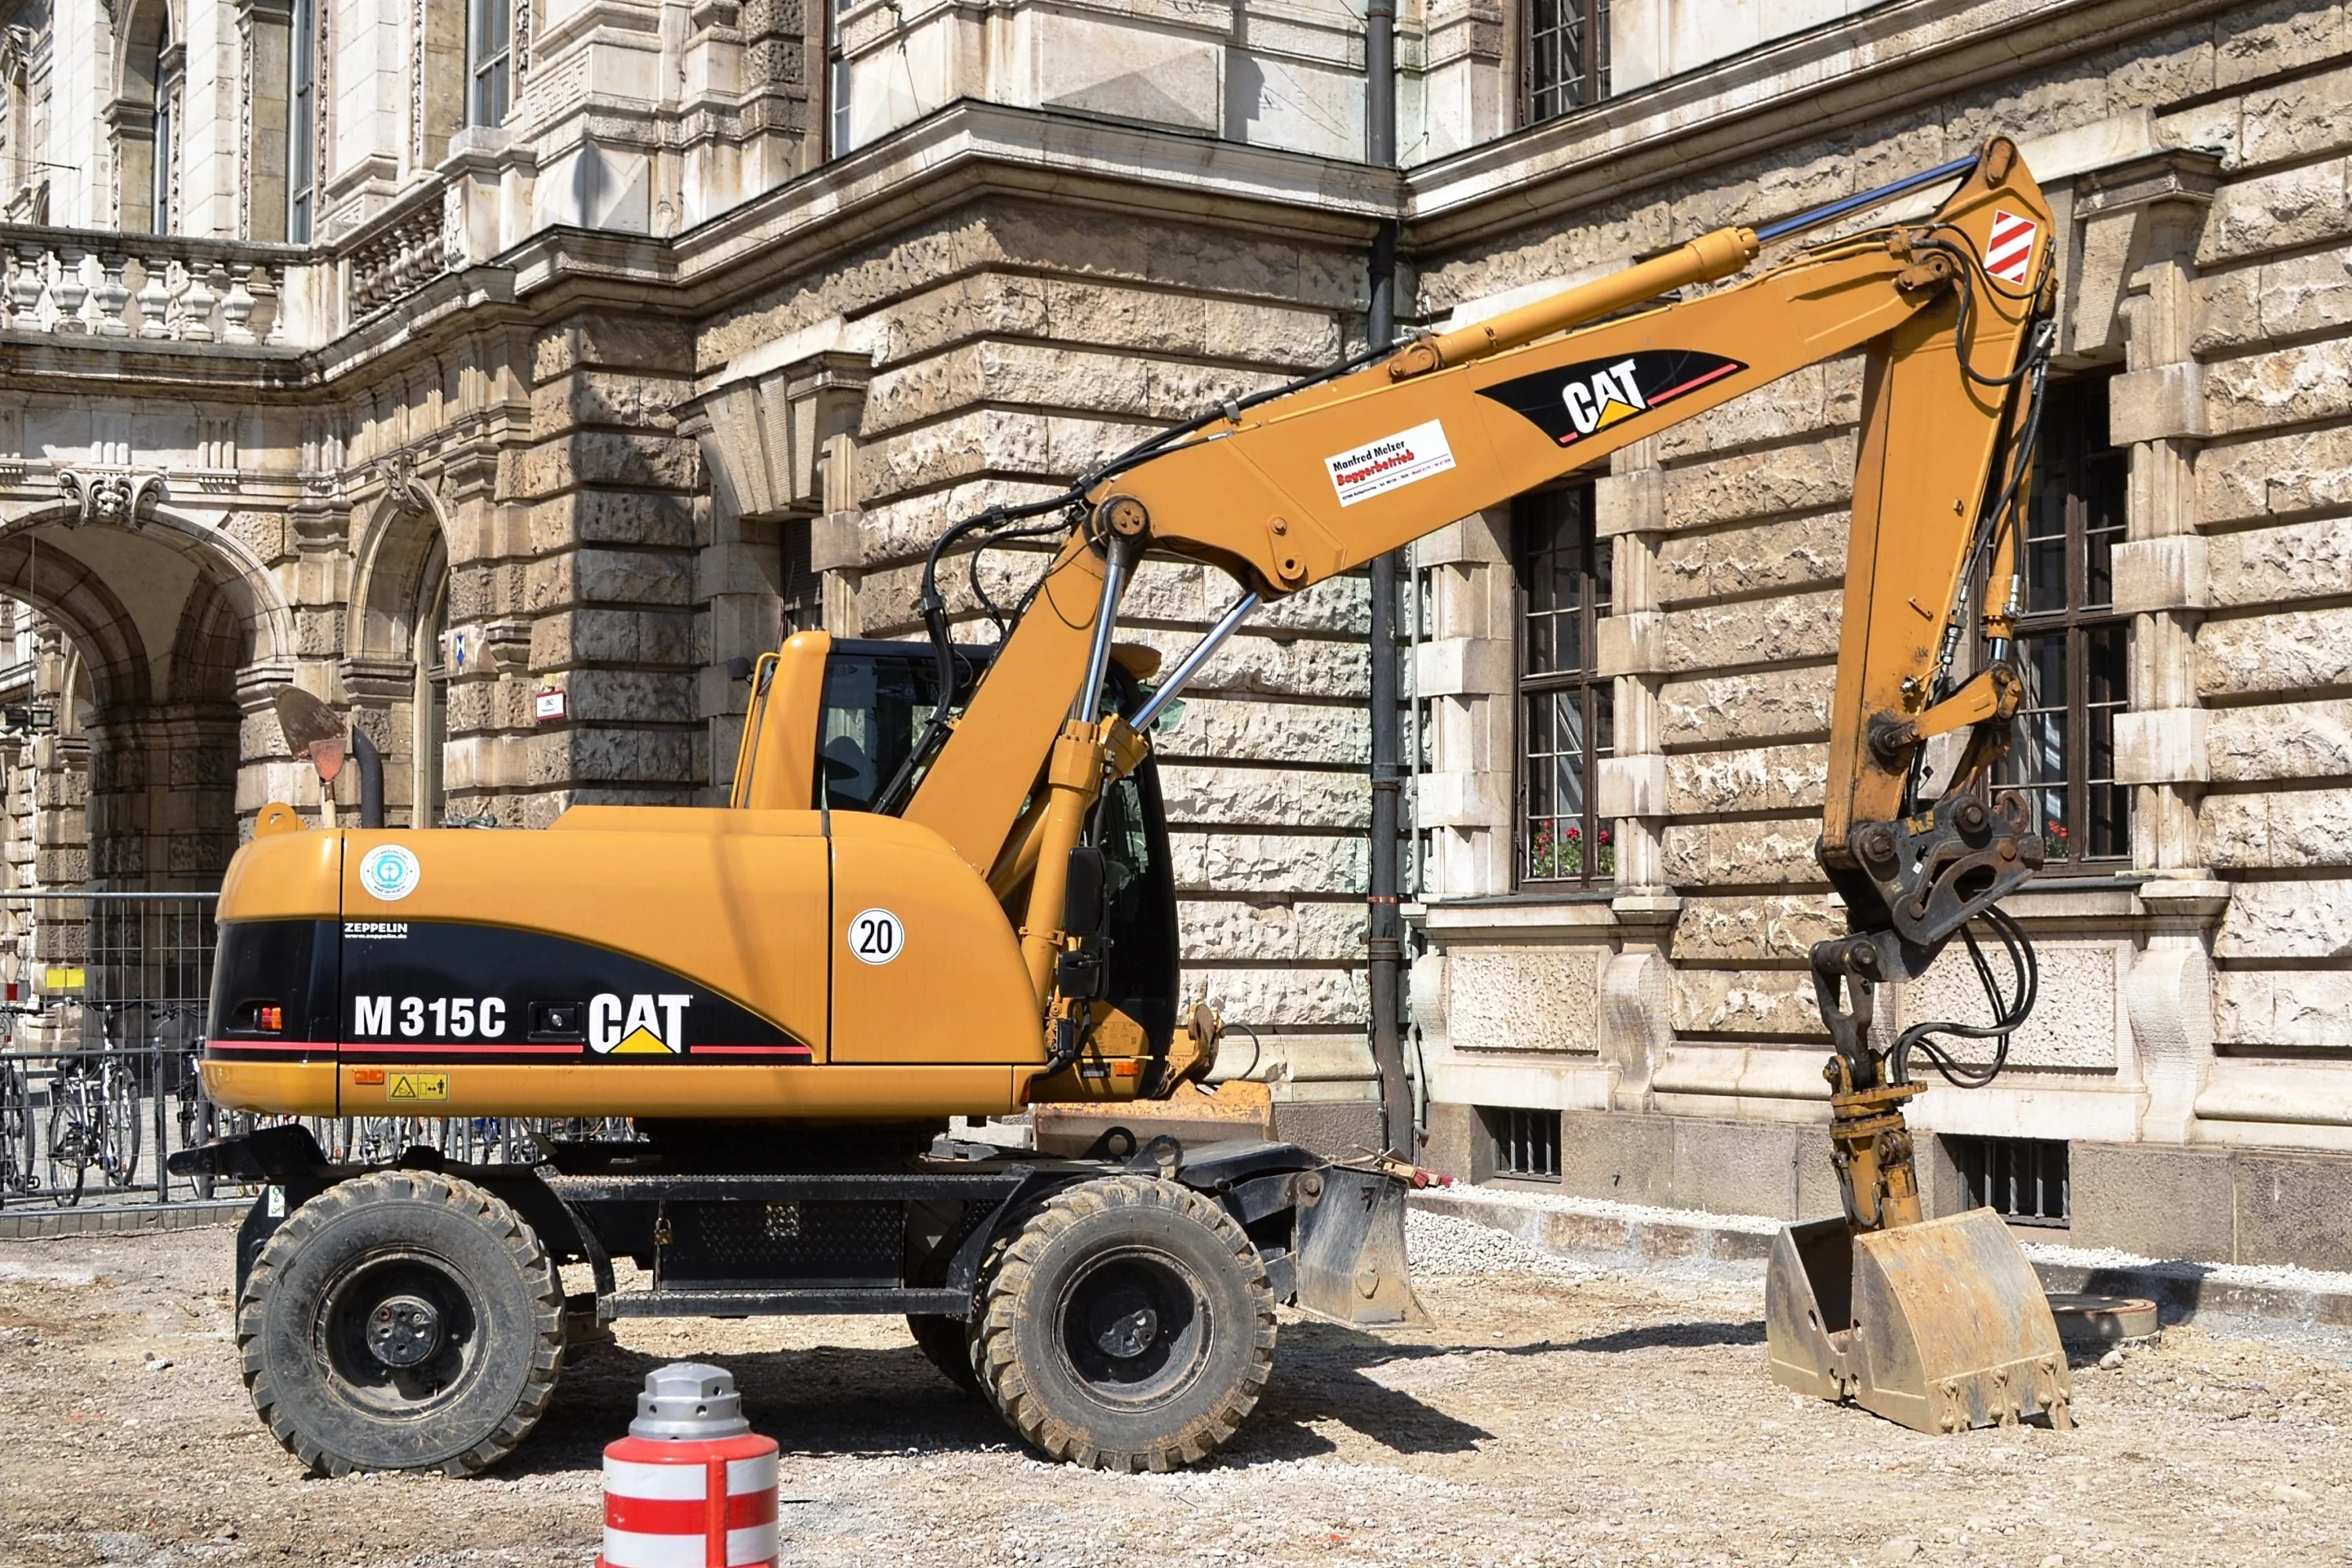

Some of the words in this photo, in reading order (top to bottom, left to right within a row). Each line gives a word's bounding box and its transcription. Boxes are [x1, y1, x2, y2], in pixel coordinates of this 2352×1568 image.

[1563, 359, 1646, 434] CAT
[1334, 450, 1373, 471] Manfred
[1374, 441, 1405, 458] Melzer
[1337, 449, 1414, 486] Baggerbetrieb
[345, 923, 408, 933] ZEPPELIN
[860, 920, 892, 953] 20
[355, 996, 392, 1036] M
[400, 997, 506, 1037] 315C
[589, 993, 691, 1054] CAT
